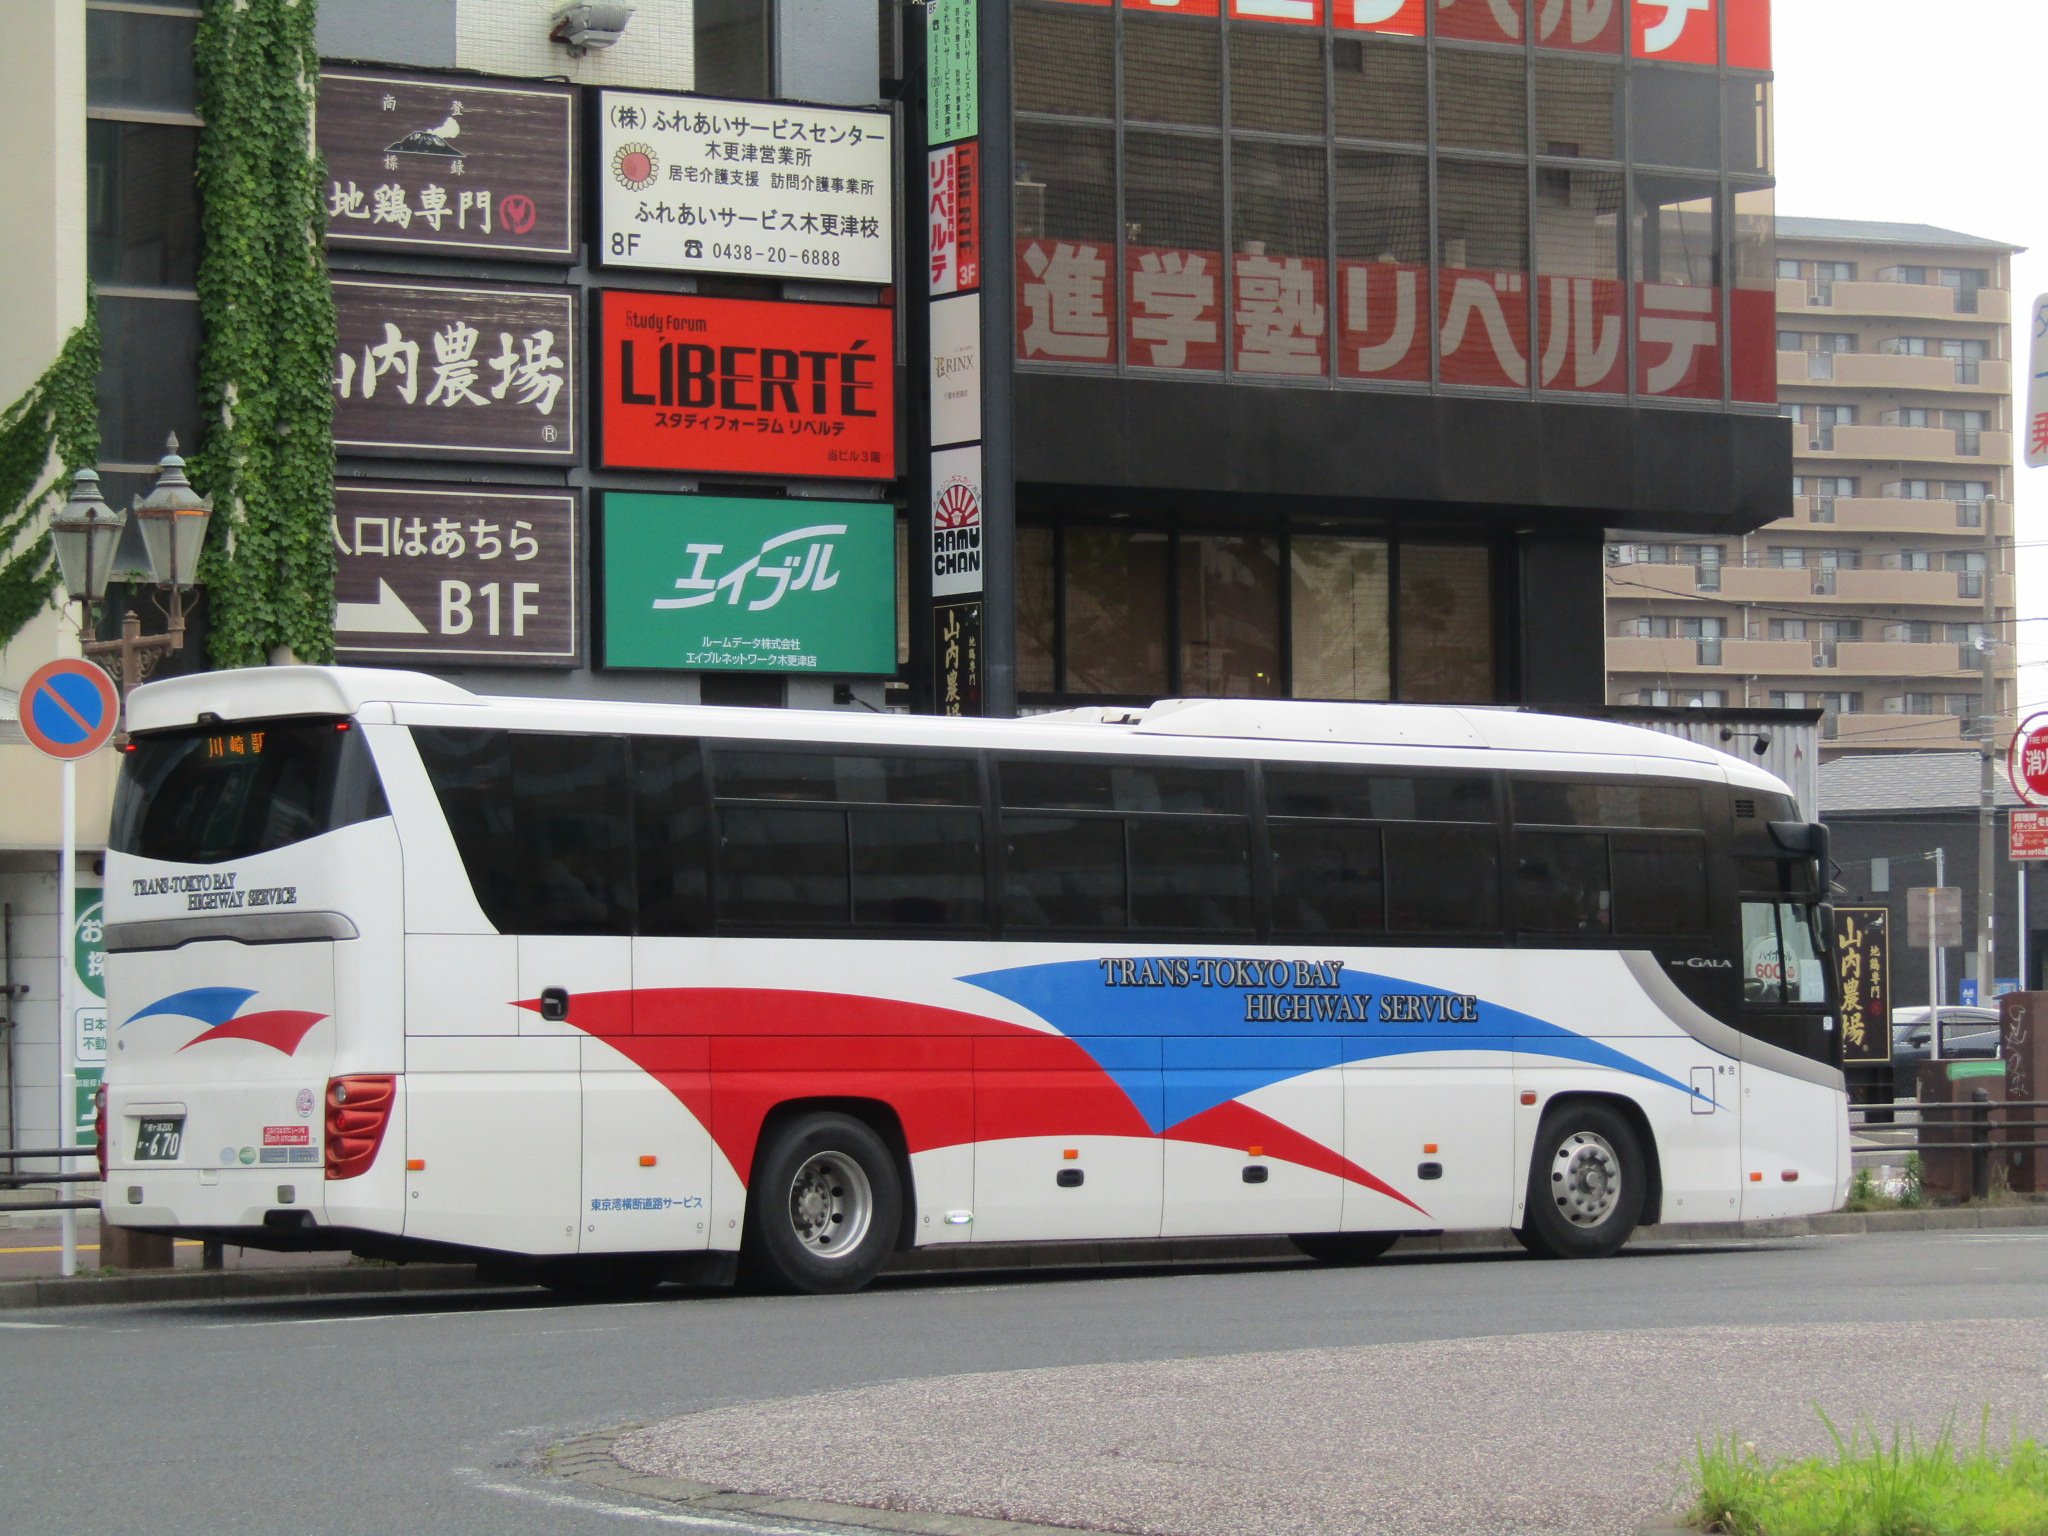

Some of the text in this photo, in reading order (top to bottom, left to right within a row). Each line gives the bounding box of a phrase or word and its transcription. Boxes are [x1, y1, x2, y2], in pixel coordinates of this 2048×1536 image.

[704, 140, 812, 167] 木更津営業所
[668, 165, 874, 196] 居宅介護支援 訪問介護事業所
[329, 181, 493, 235] 地鶏専門
[635, 201, 880, 239] ふれあいサービス木更津校
[930, 158, 948, 284] リベルテ
[611, 232, 841, 267] 8F 0438-20-6888
[959, 263, 976, 286] 3F
[626, 310, 707, 333] Study Forum
[1023, 240, 1717, 394] 進学塾リベルテ
[333, 321, 565, 416] 内農場
[655, 412, 845, 436] スタディフォーラム リベルテ
[827, 449, 881, 463] 当ビル3階
[934, 527, 980, 553] RAMU
[652, 524, 848, 611] エイブル
[934, 550, 980, 576] CHAN
[440, 579, 540, 636] B1F
[702, 636, 801, 651] ルームデータ株式会社
[686, 651, 817, 667] エイブルネットワーク木更津店
[213, 872, 237, 890] BAY
[188, 886, 297, 911] HIGHWAY SERVICE
[1100, 958, 1344, 988] TRANS-TOKYO BAY
[1687, 957, 1732, 968] GALA
[1838, 916, 1865, 1046] 山内農場
[1243, 994, 1479, 1023] HIGHWAY SERVICE
[591, 1197, 702, 1211] 東京湾横断道路サービス
